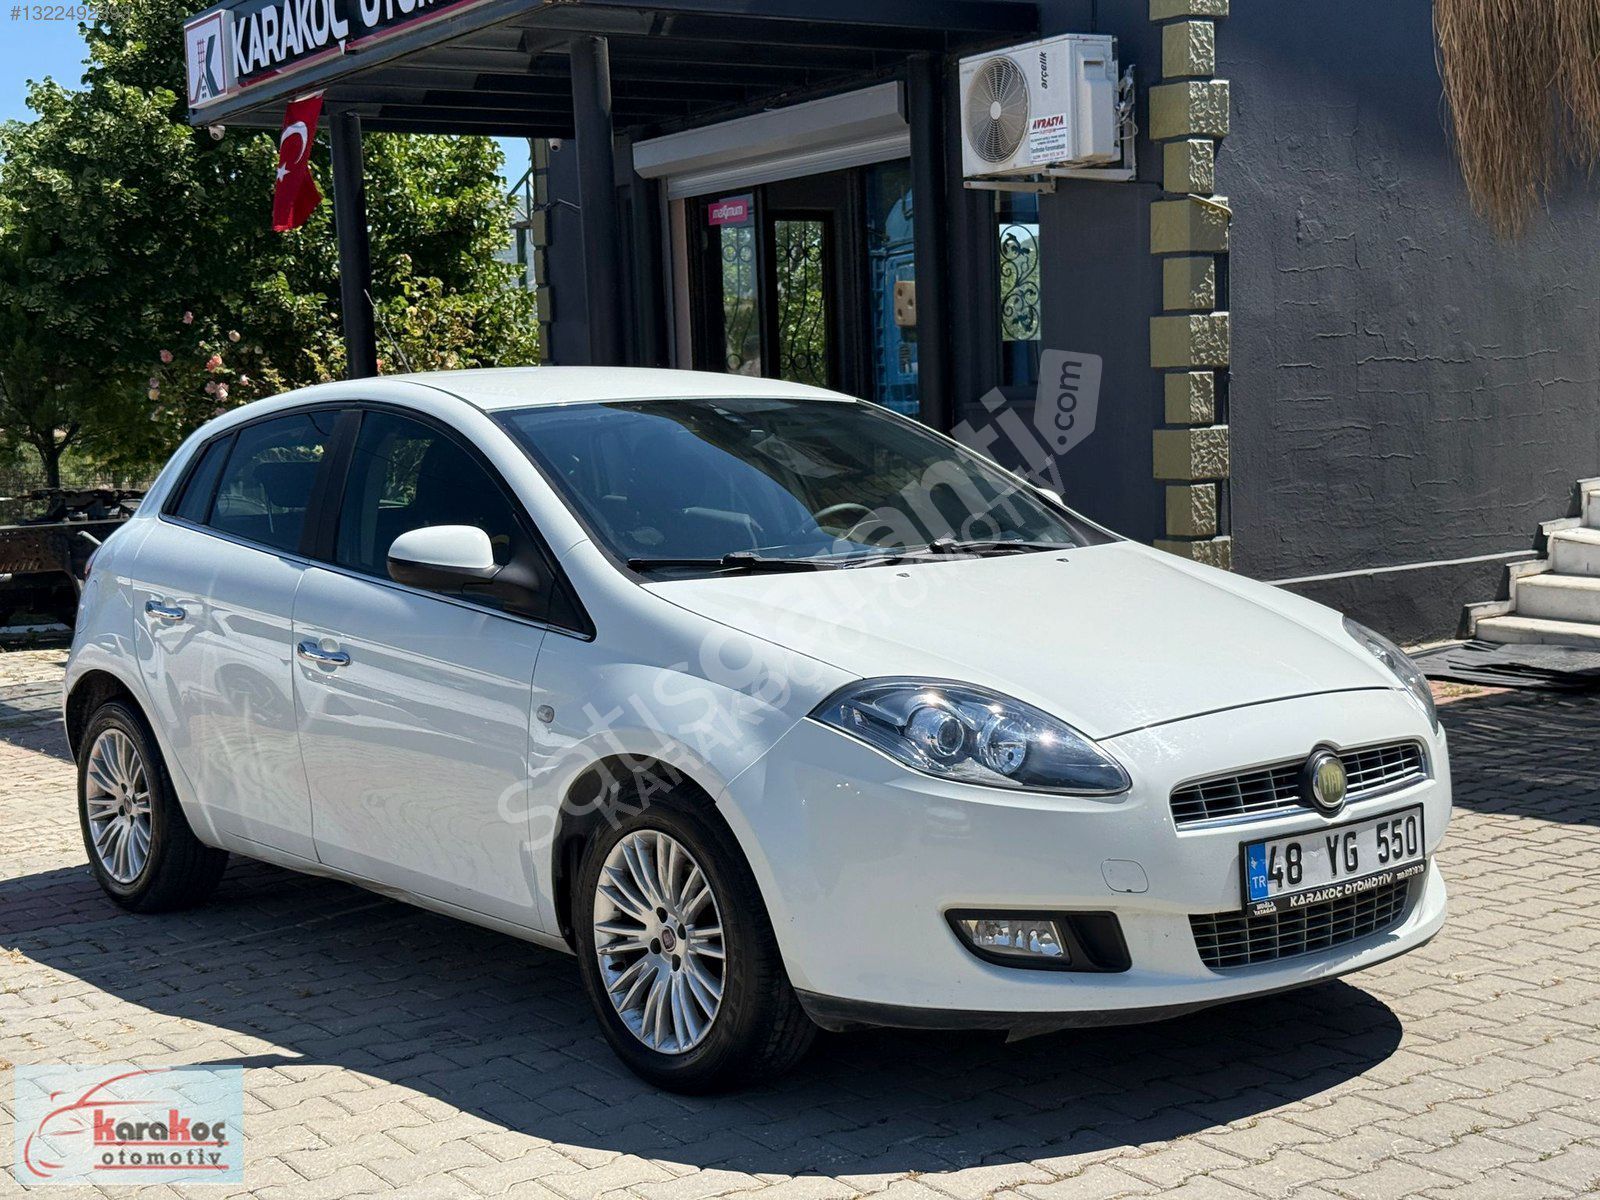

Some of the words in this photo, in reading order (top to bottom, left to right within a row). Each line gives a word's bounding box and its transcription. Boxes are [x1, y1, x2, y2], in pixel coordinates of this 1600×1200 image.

[1032, 115, 1064, 130] AVRASYA
[1252, 874, 1266, 889] TR
[1267, 843, 1303, 889] 48
[1325, 831, 1359, 877] YG
[1376, 815, 1417, 864] 550
[1290, 885, 1344, 907] KARAKOÇ
